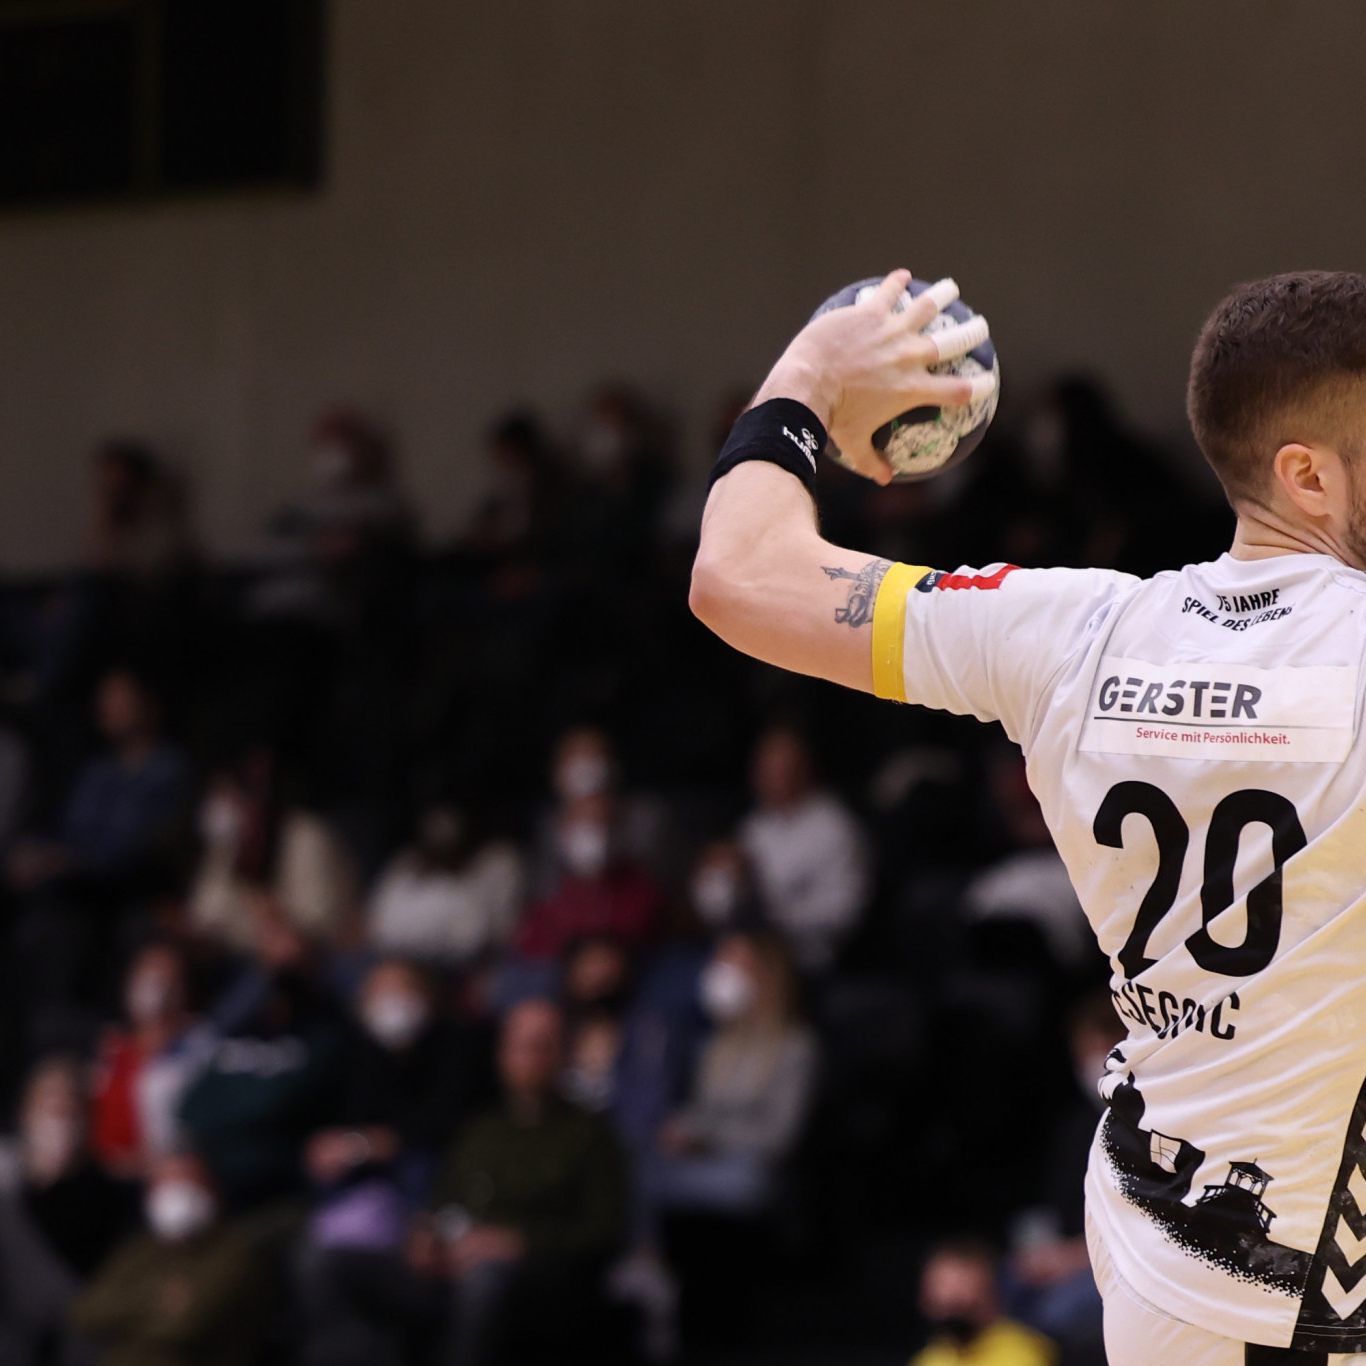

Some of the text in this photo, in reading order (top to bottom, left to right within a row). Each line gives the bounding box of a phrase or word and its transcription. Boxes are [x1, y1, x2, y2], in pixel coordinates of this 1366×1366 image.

[1181, 596, 1219, 624] SPIEL
[1221, 618, 1252, 632] DES
[1216, 594, 1231, 612] 75
[1098, 675, 1262, 719] GERSTER
[1135, 727, 1291, 745] Service mit Persönlichkeit.
[1093, 780, 1307, 977] 20
